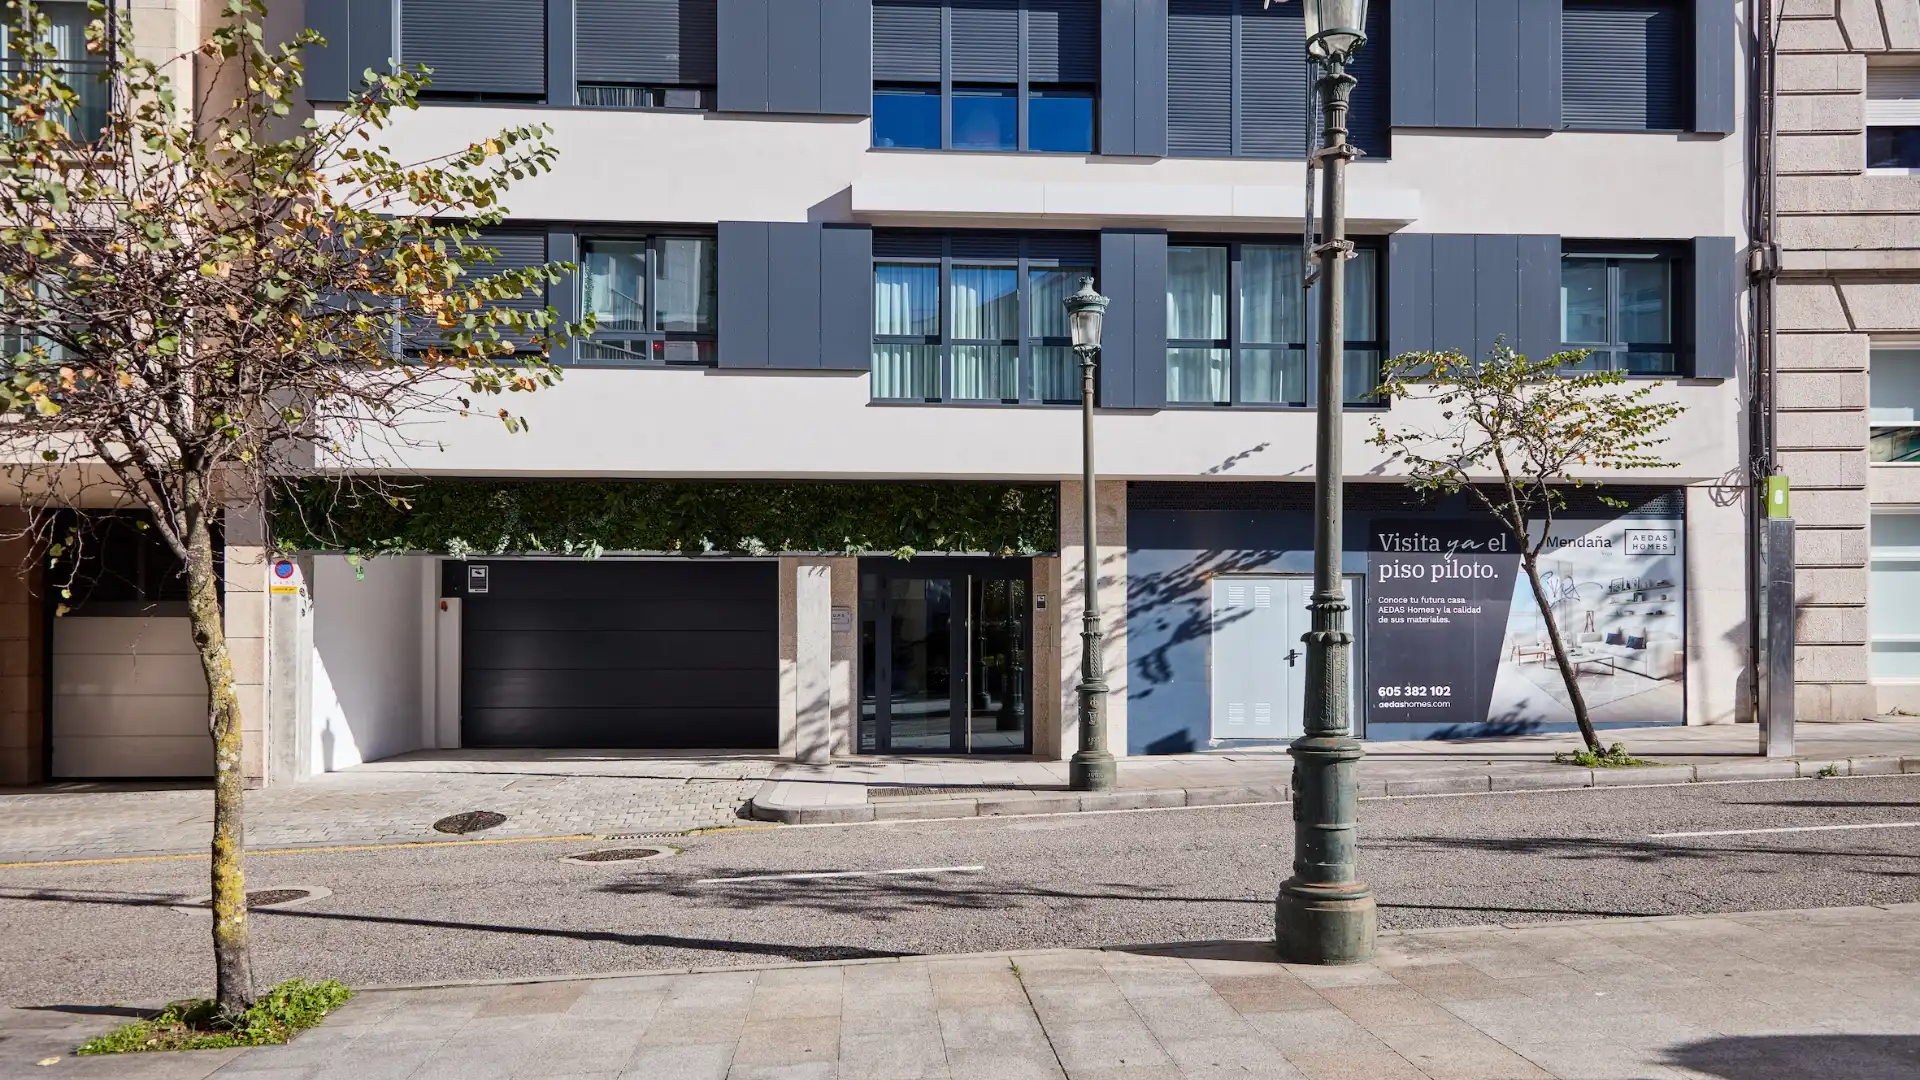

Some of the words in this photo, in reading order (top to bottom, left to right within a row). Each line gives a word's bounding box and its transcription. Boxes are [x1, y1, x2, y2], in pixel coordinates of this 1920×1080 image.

[1378, 532, 1441, 552] Visita
[1444, 539, 1484, 560] ya
[1488, 533, 1507, 552] el
[1546, 535, 1612, 548] Mendaña
[1378, 559, 1425, 583] piso
[1430, 559, 1499, 583] piloto.
[1378, 596, 1408, 604] Conoce
[1410, 596, 1419, 604] tu
[1420, 595, 1446, 604] futura
[1378, 606, 1405, 614] AEDAS
[1407, 606, 1435, 614] Homes
[1436, 607, 1441, 616] y
[1443, 606, 1451, 614] la
[1452, 606, 1482, 614] calidad
[1378, 616, 1388, 624] de
[1406, 616, 1450, 624] materiales.
[1378, 686, 1401, 697] 605
[1404, 686, 1427, 697] 382
[1429, 686, 1451, 697] 102
[1378, 700, 1451, 708] aedashomes.com
